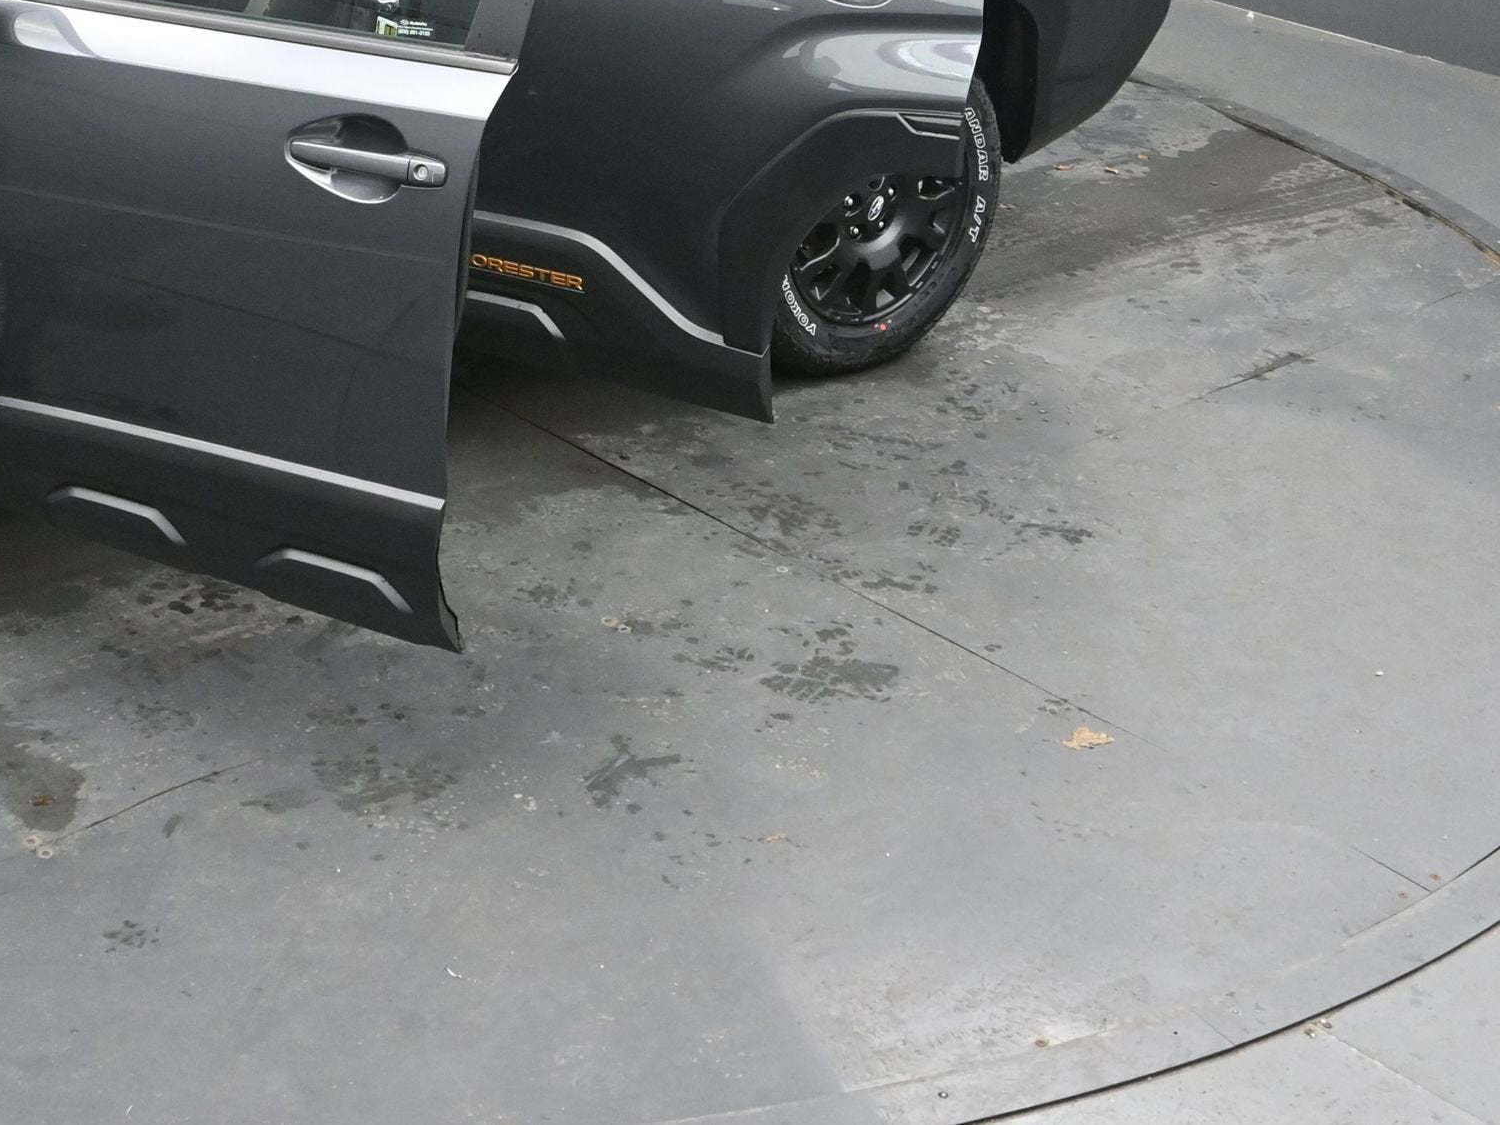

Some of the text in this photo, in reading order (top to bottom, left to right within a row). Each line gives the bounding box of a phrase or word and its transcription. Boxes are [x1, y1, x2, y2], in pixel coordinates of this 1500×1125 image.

[964, 107, 989, 243] ANDAR A/T
[471, 253, 584, 291] ORESTER
[781, 274, 817, 336] YOKO
